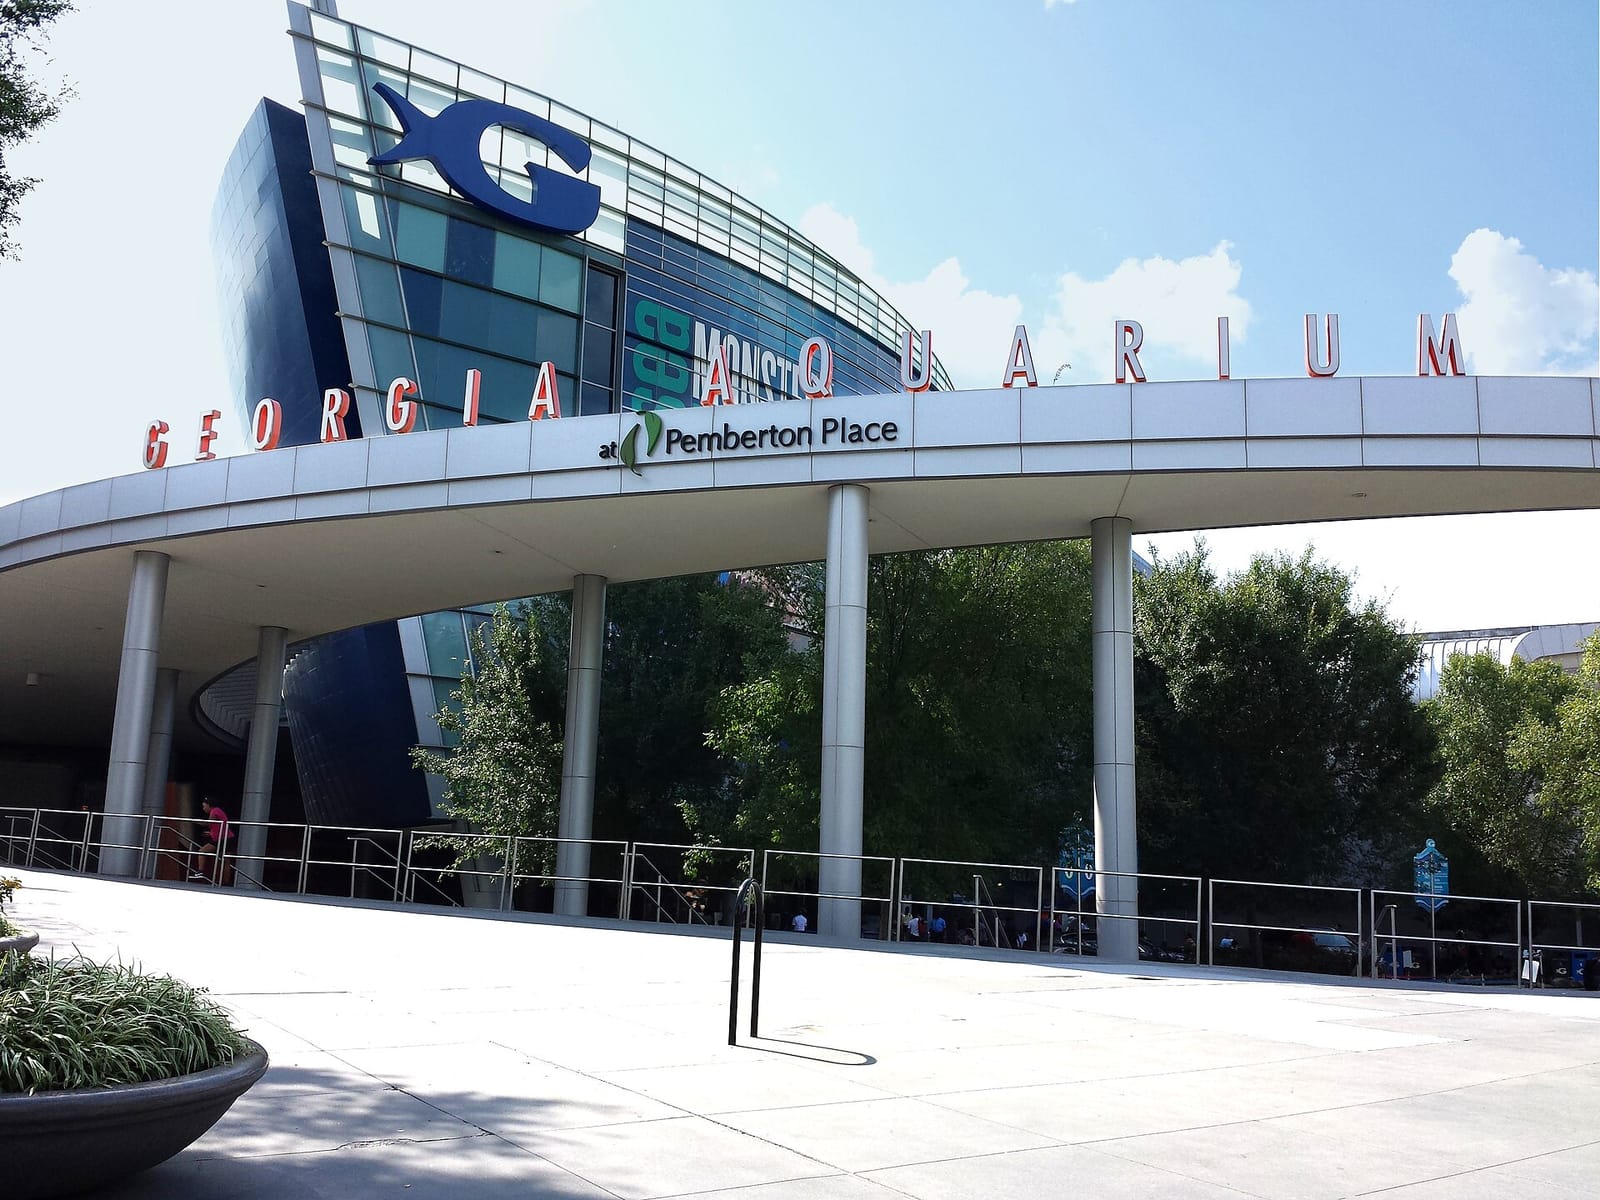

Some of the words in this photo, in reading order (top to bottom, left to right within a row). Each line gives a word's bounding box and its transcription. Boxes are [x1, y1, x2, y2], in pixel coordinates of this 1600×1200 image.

[366, 82, 601, 235] G
[142, 360, 563, 469] GEORGIA
[700, 312, 1467, 407] AQUARIUM
[692, 320, 834, 404] MONST
[598, 441, 618, 459] at
[665, 422, 813, 455] Pemberton
[820, 416, 898, 445] Place
